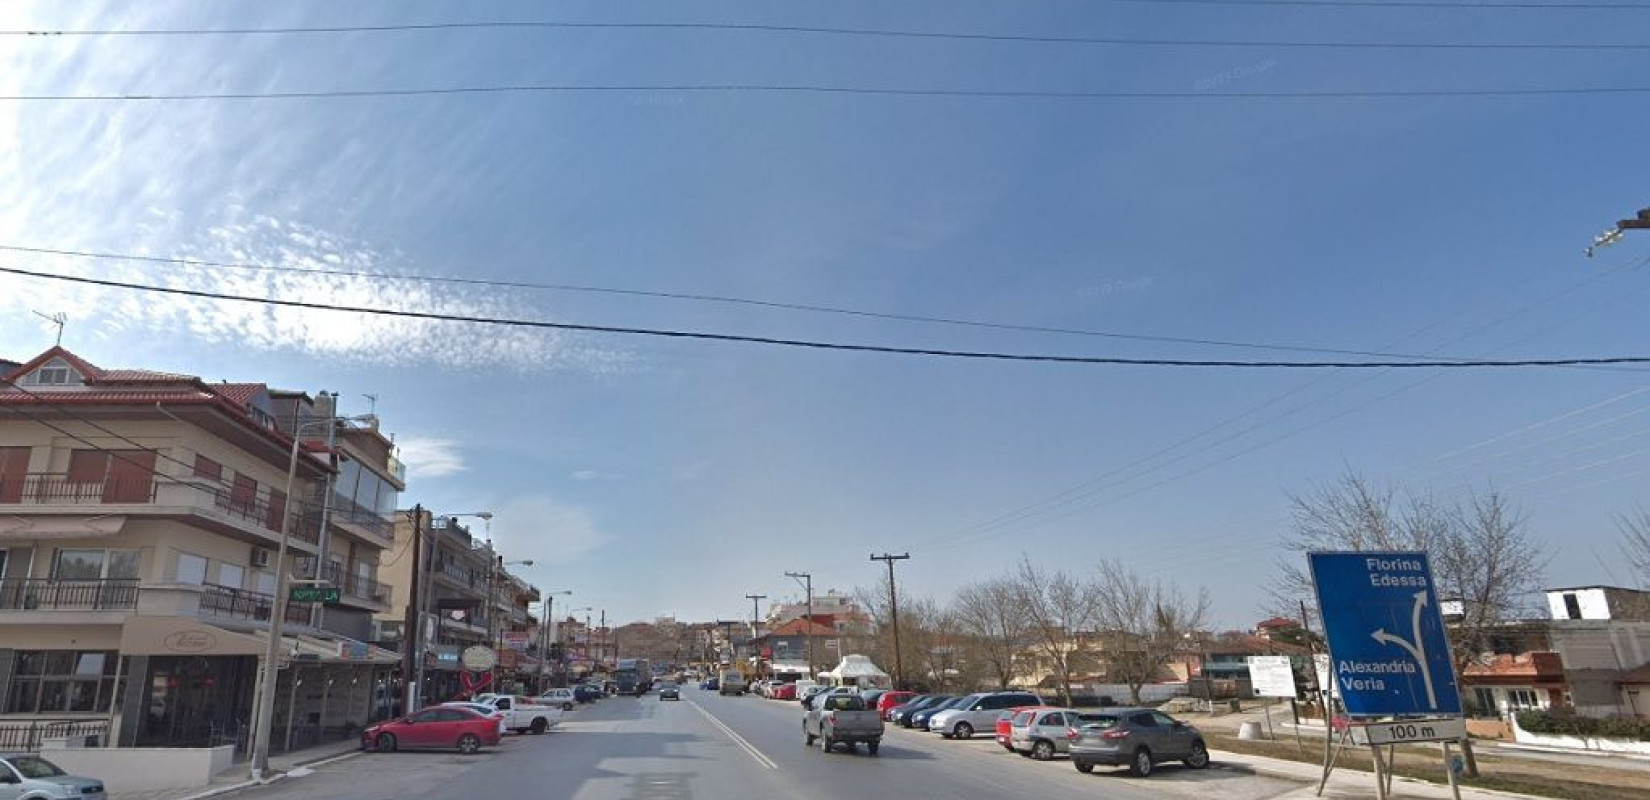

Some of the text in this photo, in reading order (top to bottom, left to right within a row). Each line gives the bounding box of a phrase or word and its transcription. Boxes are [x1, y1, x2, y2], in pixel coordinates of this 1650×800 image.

[1366, 558, 1422, 571] Florina
[1370, 573, 1427, 586] Edessa
[1339, 660, 1417, 674] Alexandria
[1341, 676, 1386, 691] Veria
[1388, 724, 1436, 739] 100 m
